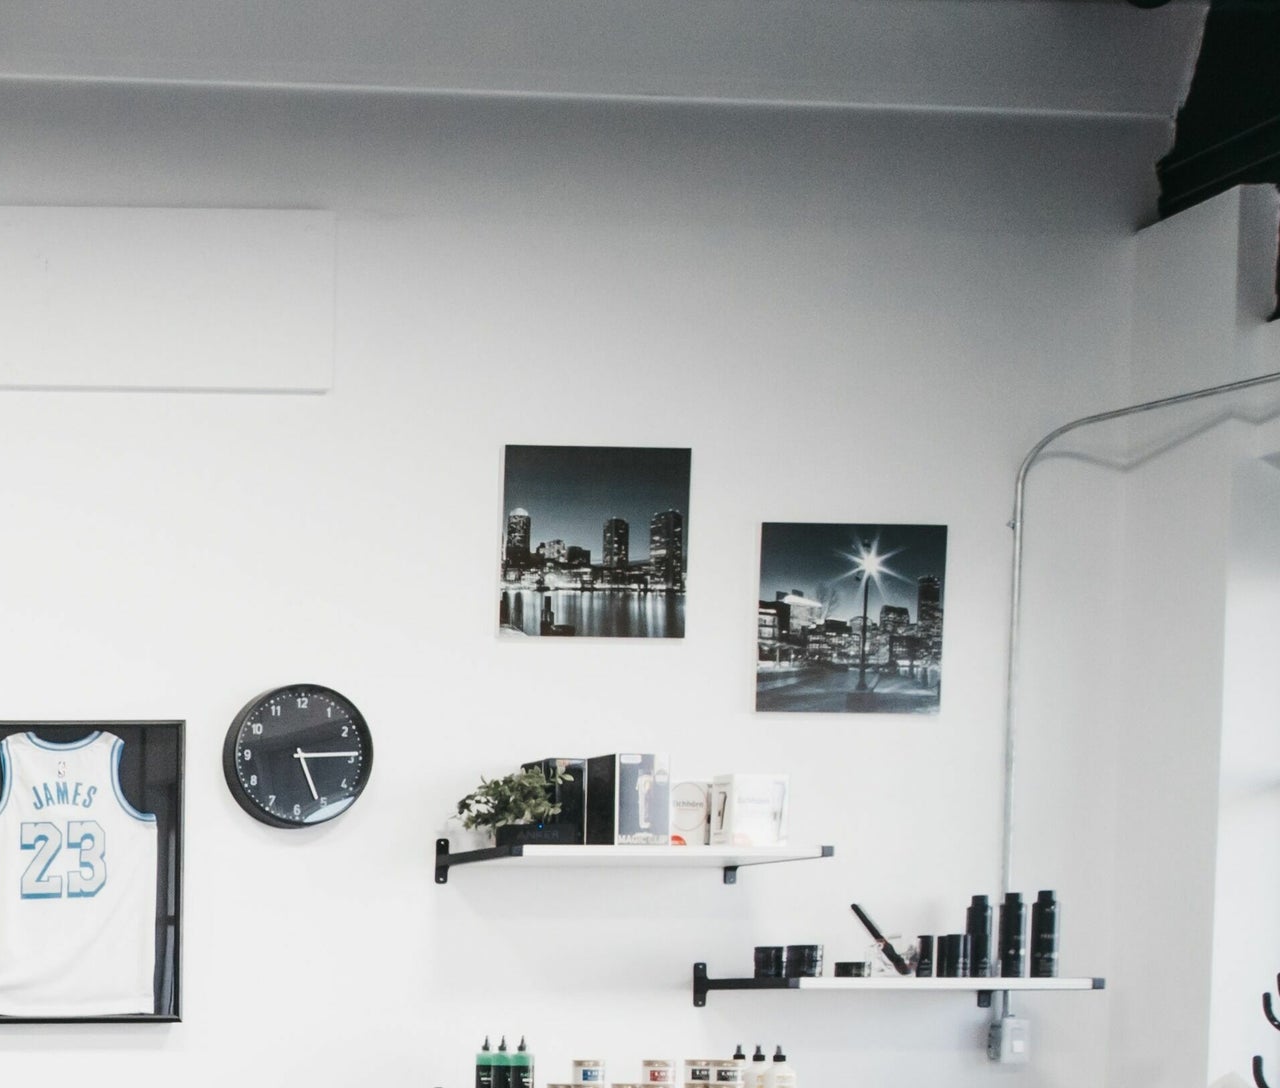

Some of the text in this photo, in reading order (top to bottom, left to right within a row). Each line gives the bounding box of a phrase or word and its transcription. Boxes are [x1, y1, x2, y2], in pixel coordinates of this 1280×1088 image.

[296, 697, 309, 709] 12
[270, 705, 281, 716] 11
[326, 707, 332, 718] 1
[251, 723, 263, 735] 10
[341, 726, 348, 737] 2
[243, 749, 252, 761] 9
[250, 774, 258, 786] 8
[340, 778, 348, 789] 4
[32, 781, 98, 811] JAMES
[268, 795, 276, 806] 7
[320, 797, 328, 808] 5
[293, 804, 301, 815] 6
[20, 820, 107, 899] 23
